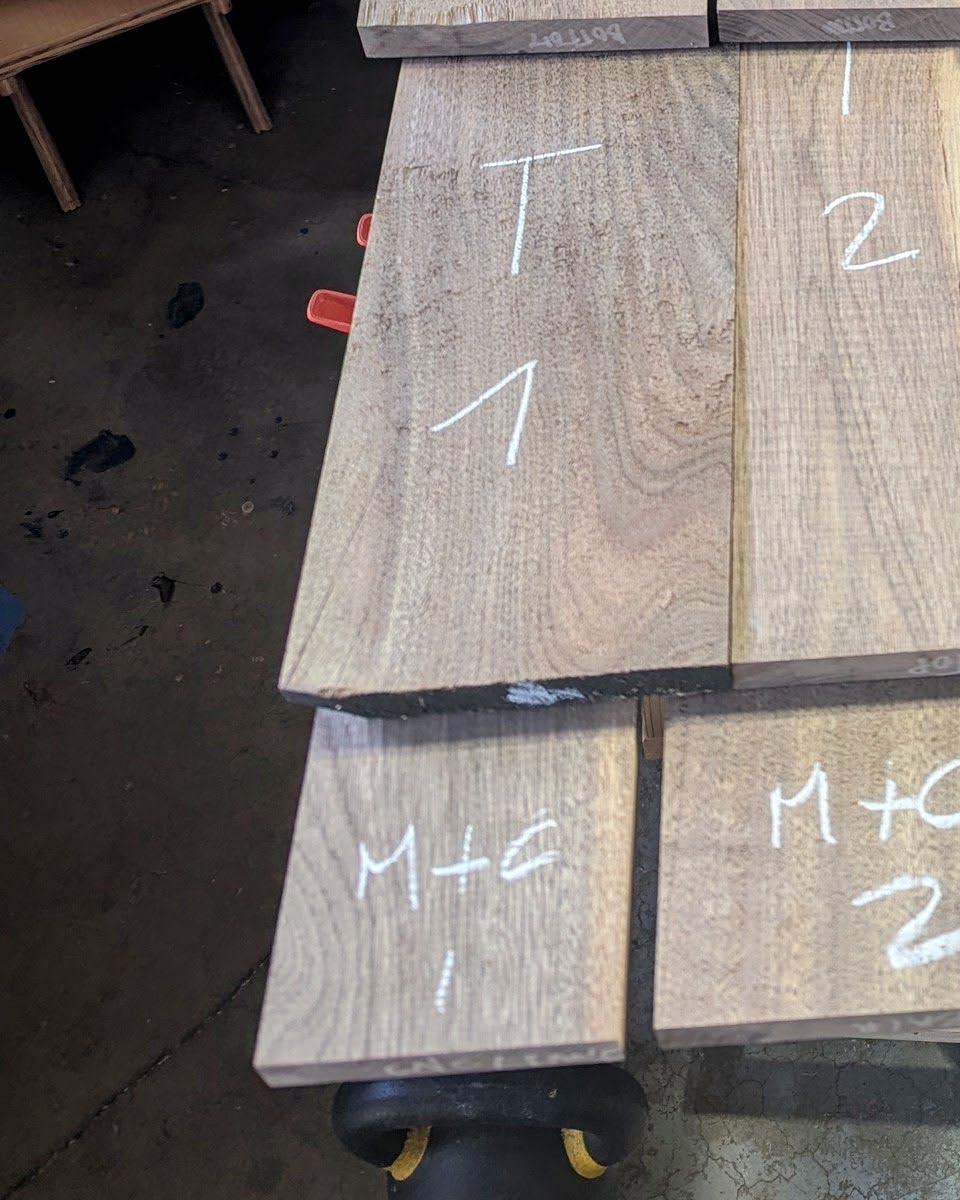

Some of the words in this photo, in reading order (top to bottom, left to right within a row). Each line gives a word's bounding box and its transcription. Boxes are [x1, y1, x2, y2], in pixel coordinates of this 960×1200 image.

[480, 144, 602, 275] T
[822, 191, 920, 271] 2
[430, 359, 538, 466] 1
